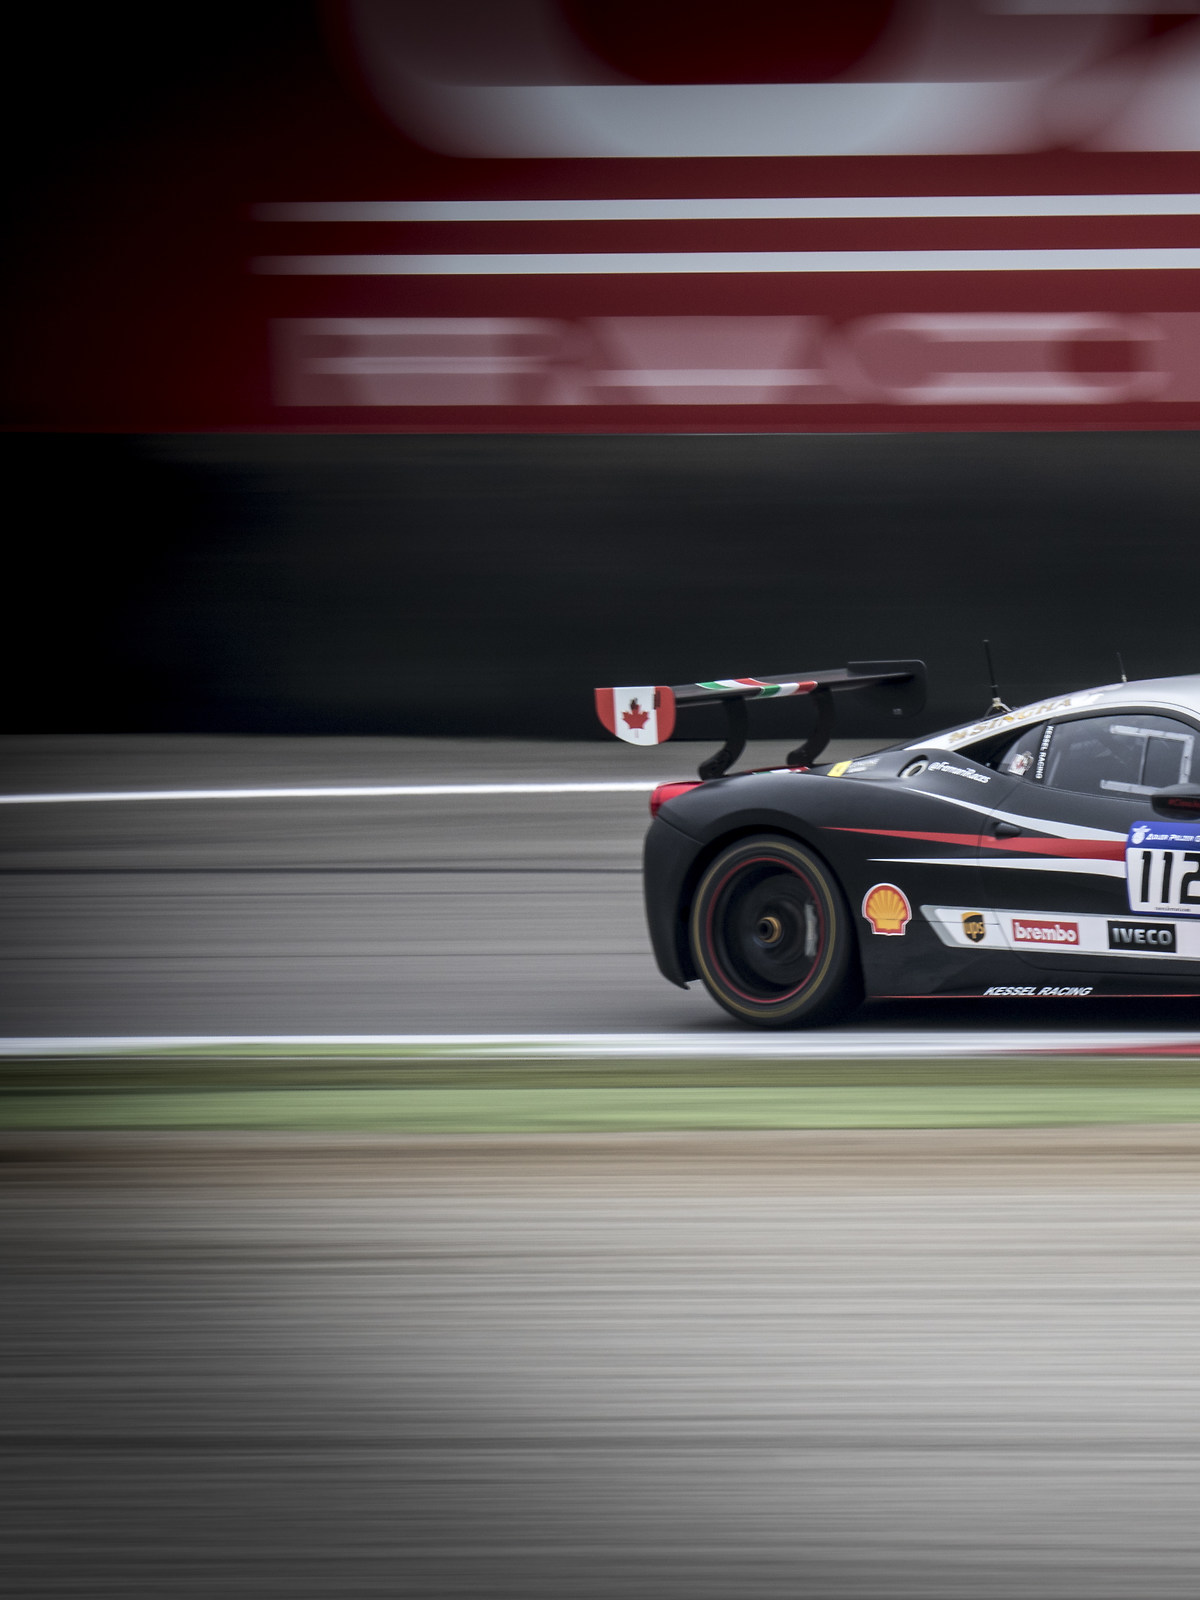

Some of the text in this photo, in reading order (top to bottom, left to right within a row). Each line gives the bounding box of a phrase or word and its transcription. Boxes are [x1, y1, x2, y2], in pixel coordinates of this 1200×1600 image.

[964, 921, 985, 939] ups
[1014, 922, 1077, 942] brembo
[1111, 927, 1173, 946] IVECO
[983, 986, 1093, 996] KESSEL RACING
